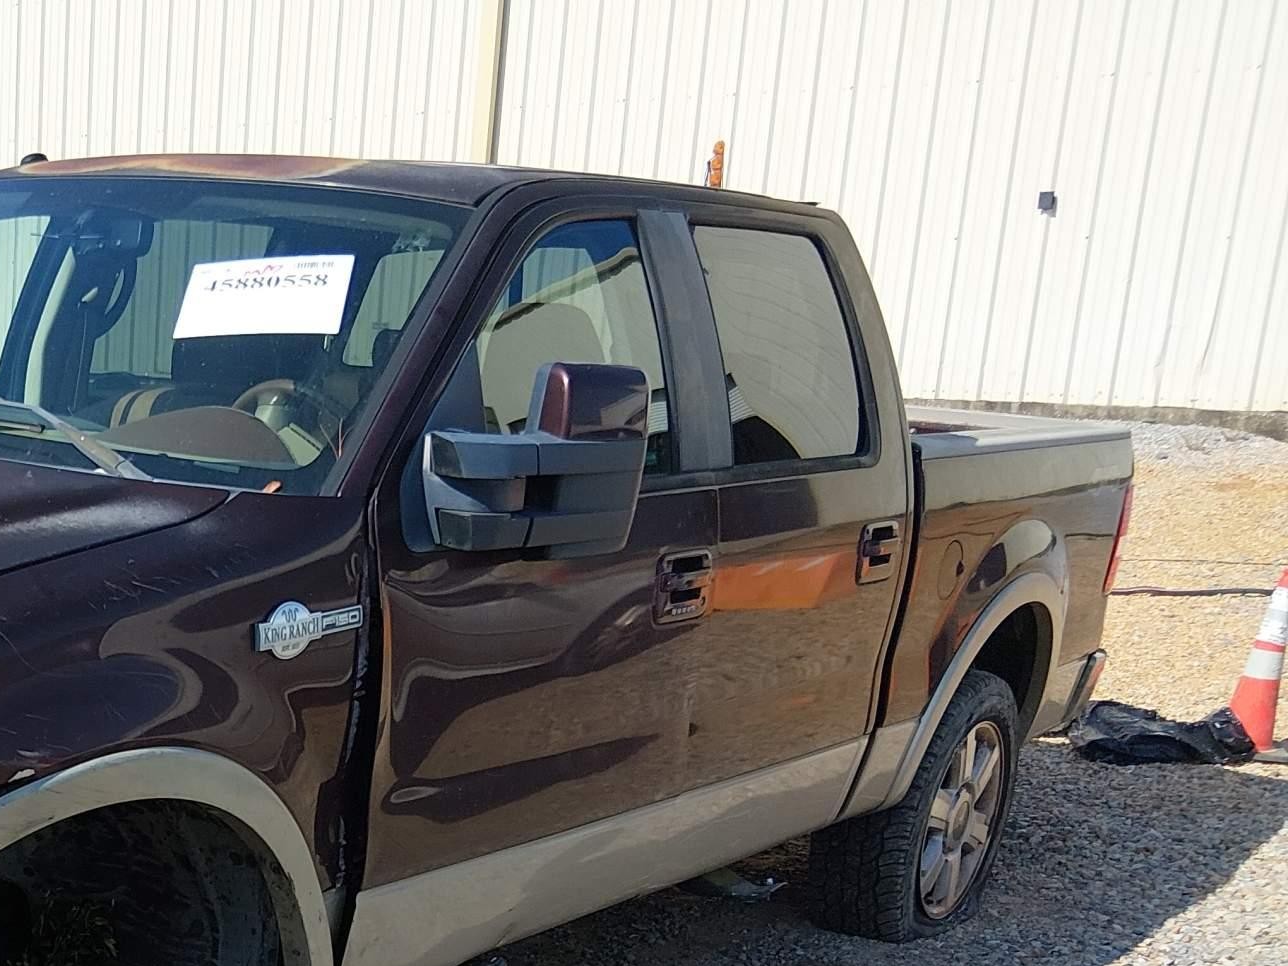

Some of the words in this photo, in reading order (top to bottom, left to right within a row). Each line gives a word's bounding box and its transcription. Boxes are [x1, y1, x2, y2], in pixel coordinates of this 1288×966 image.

[204, 274, 328, 292] 45880558
[263, 625, 287, 645] KING
[289, 617, 319, 640] RANCH
